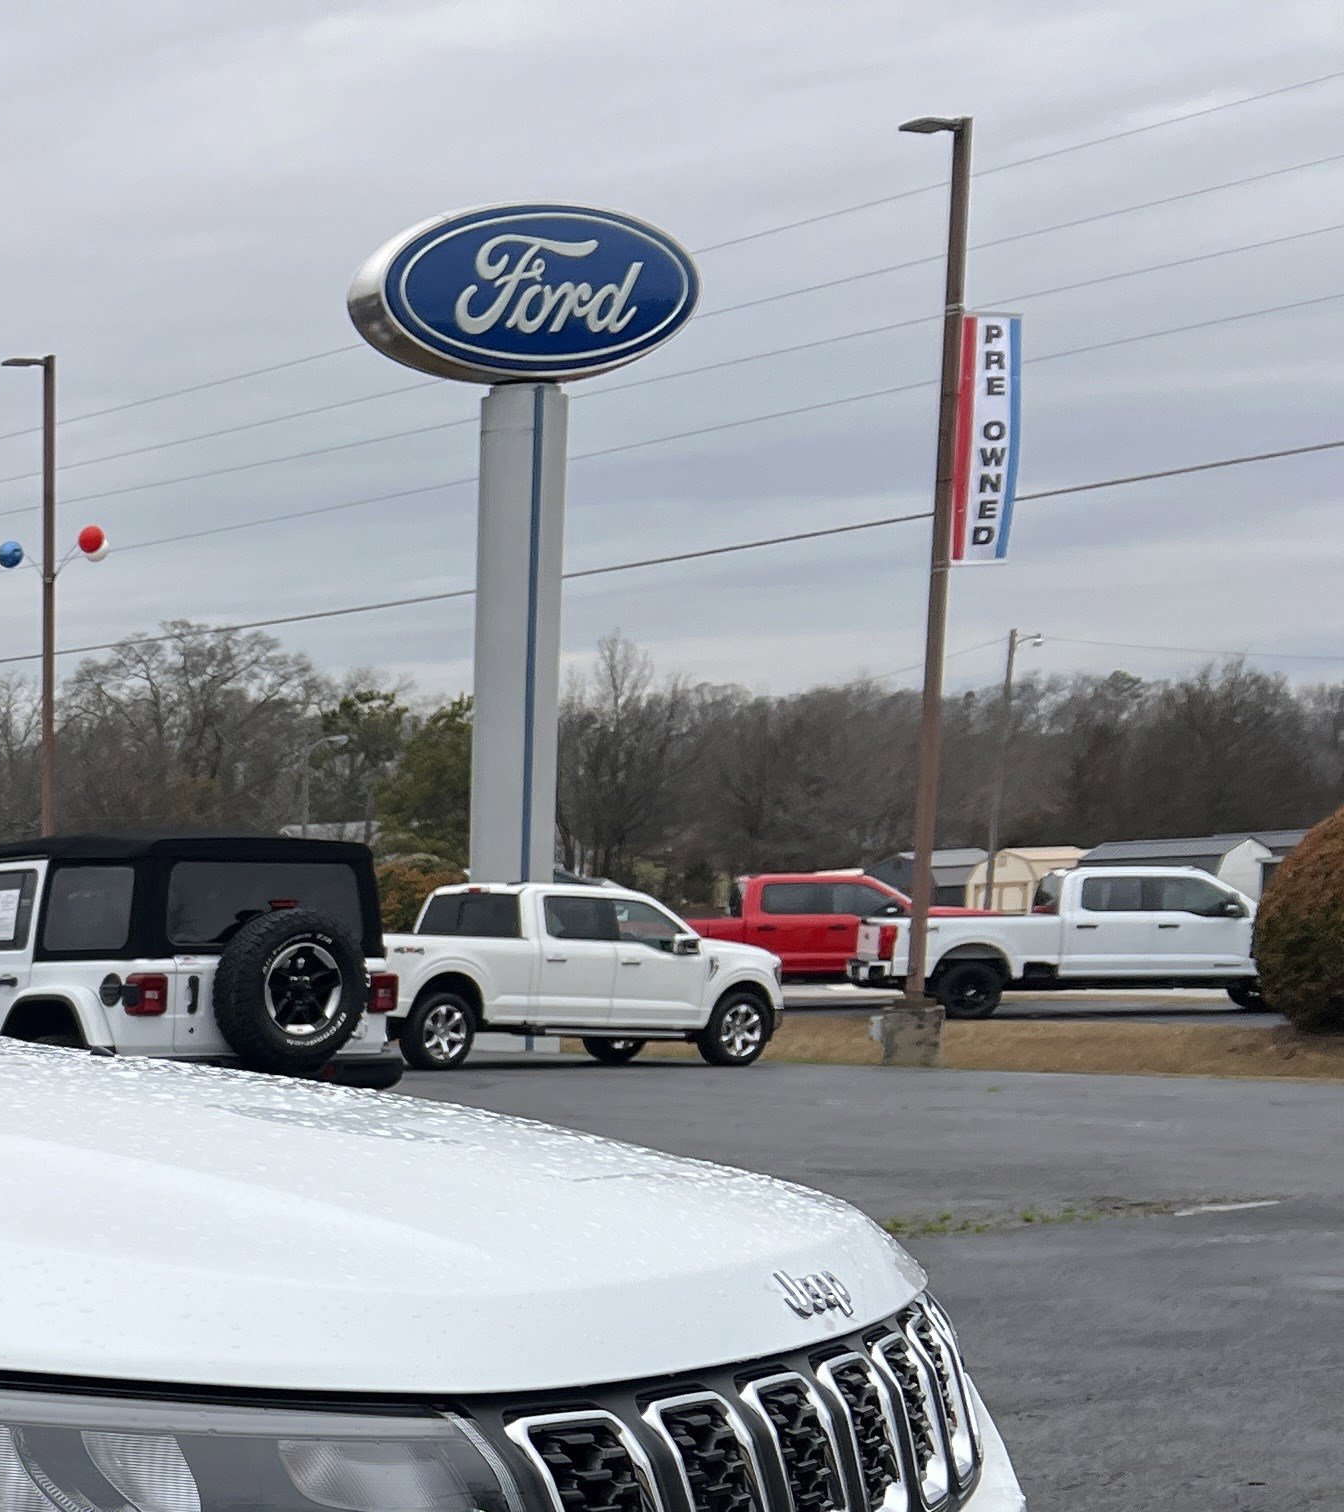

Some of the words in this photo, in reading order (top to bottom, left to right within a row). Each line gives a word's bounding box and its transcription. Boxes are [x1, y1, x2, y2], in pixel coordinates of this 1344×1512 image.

[455, 234, 644, 334] Ford
[984, 324, 1006, 396] PRE
[972, 420, 1007, 546] OWNED
[773, 1269, 854, 1319] Jeep
